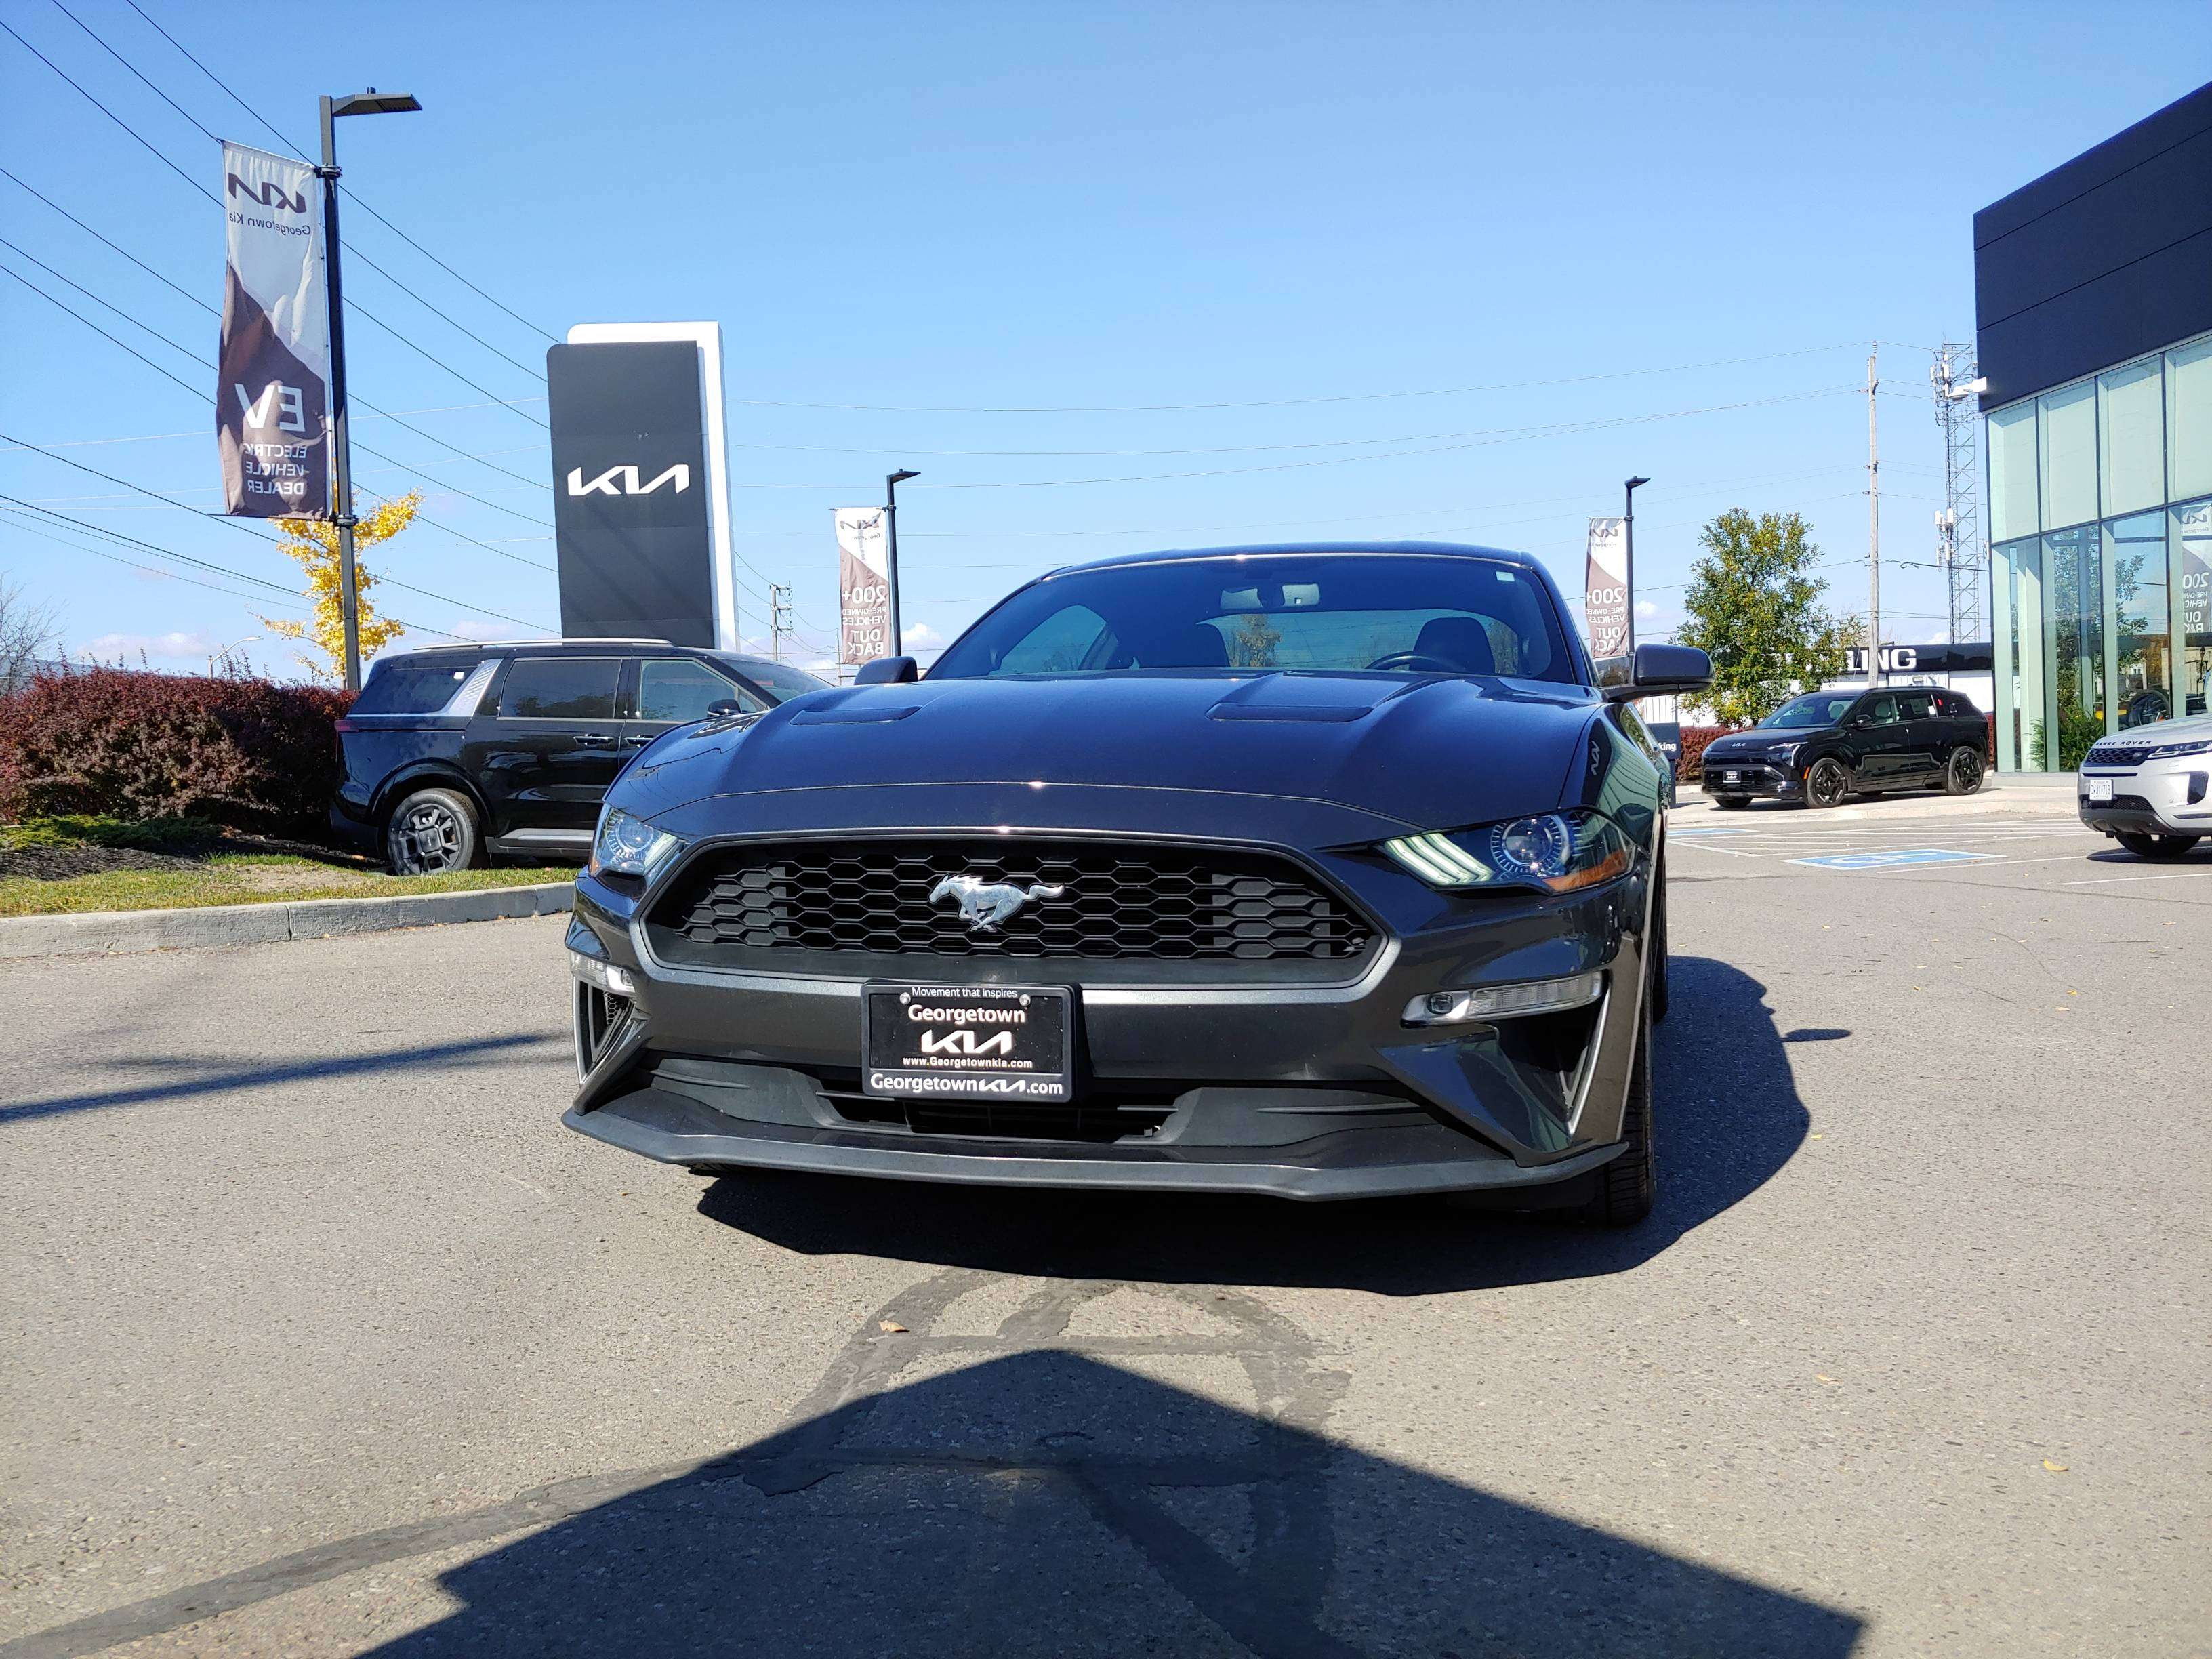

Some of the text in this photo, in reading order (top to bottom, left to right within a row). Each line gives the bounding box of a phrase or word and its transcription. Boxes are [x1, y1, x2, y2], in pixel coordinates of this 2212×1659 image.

[567, 464, 689, 496] KIA
[912, 987, 1017, 999] Movement that inspires
[908, 1004, 1026, 1025] Georgetown
[921, 1029, 1012, 1054] KIA
